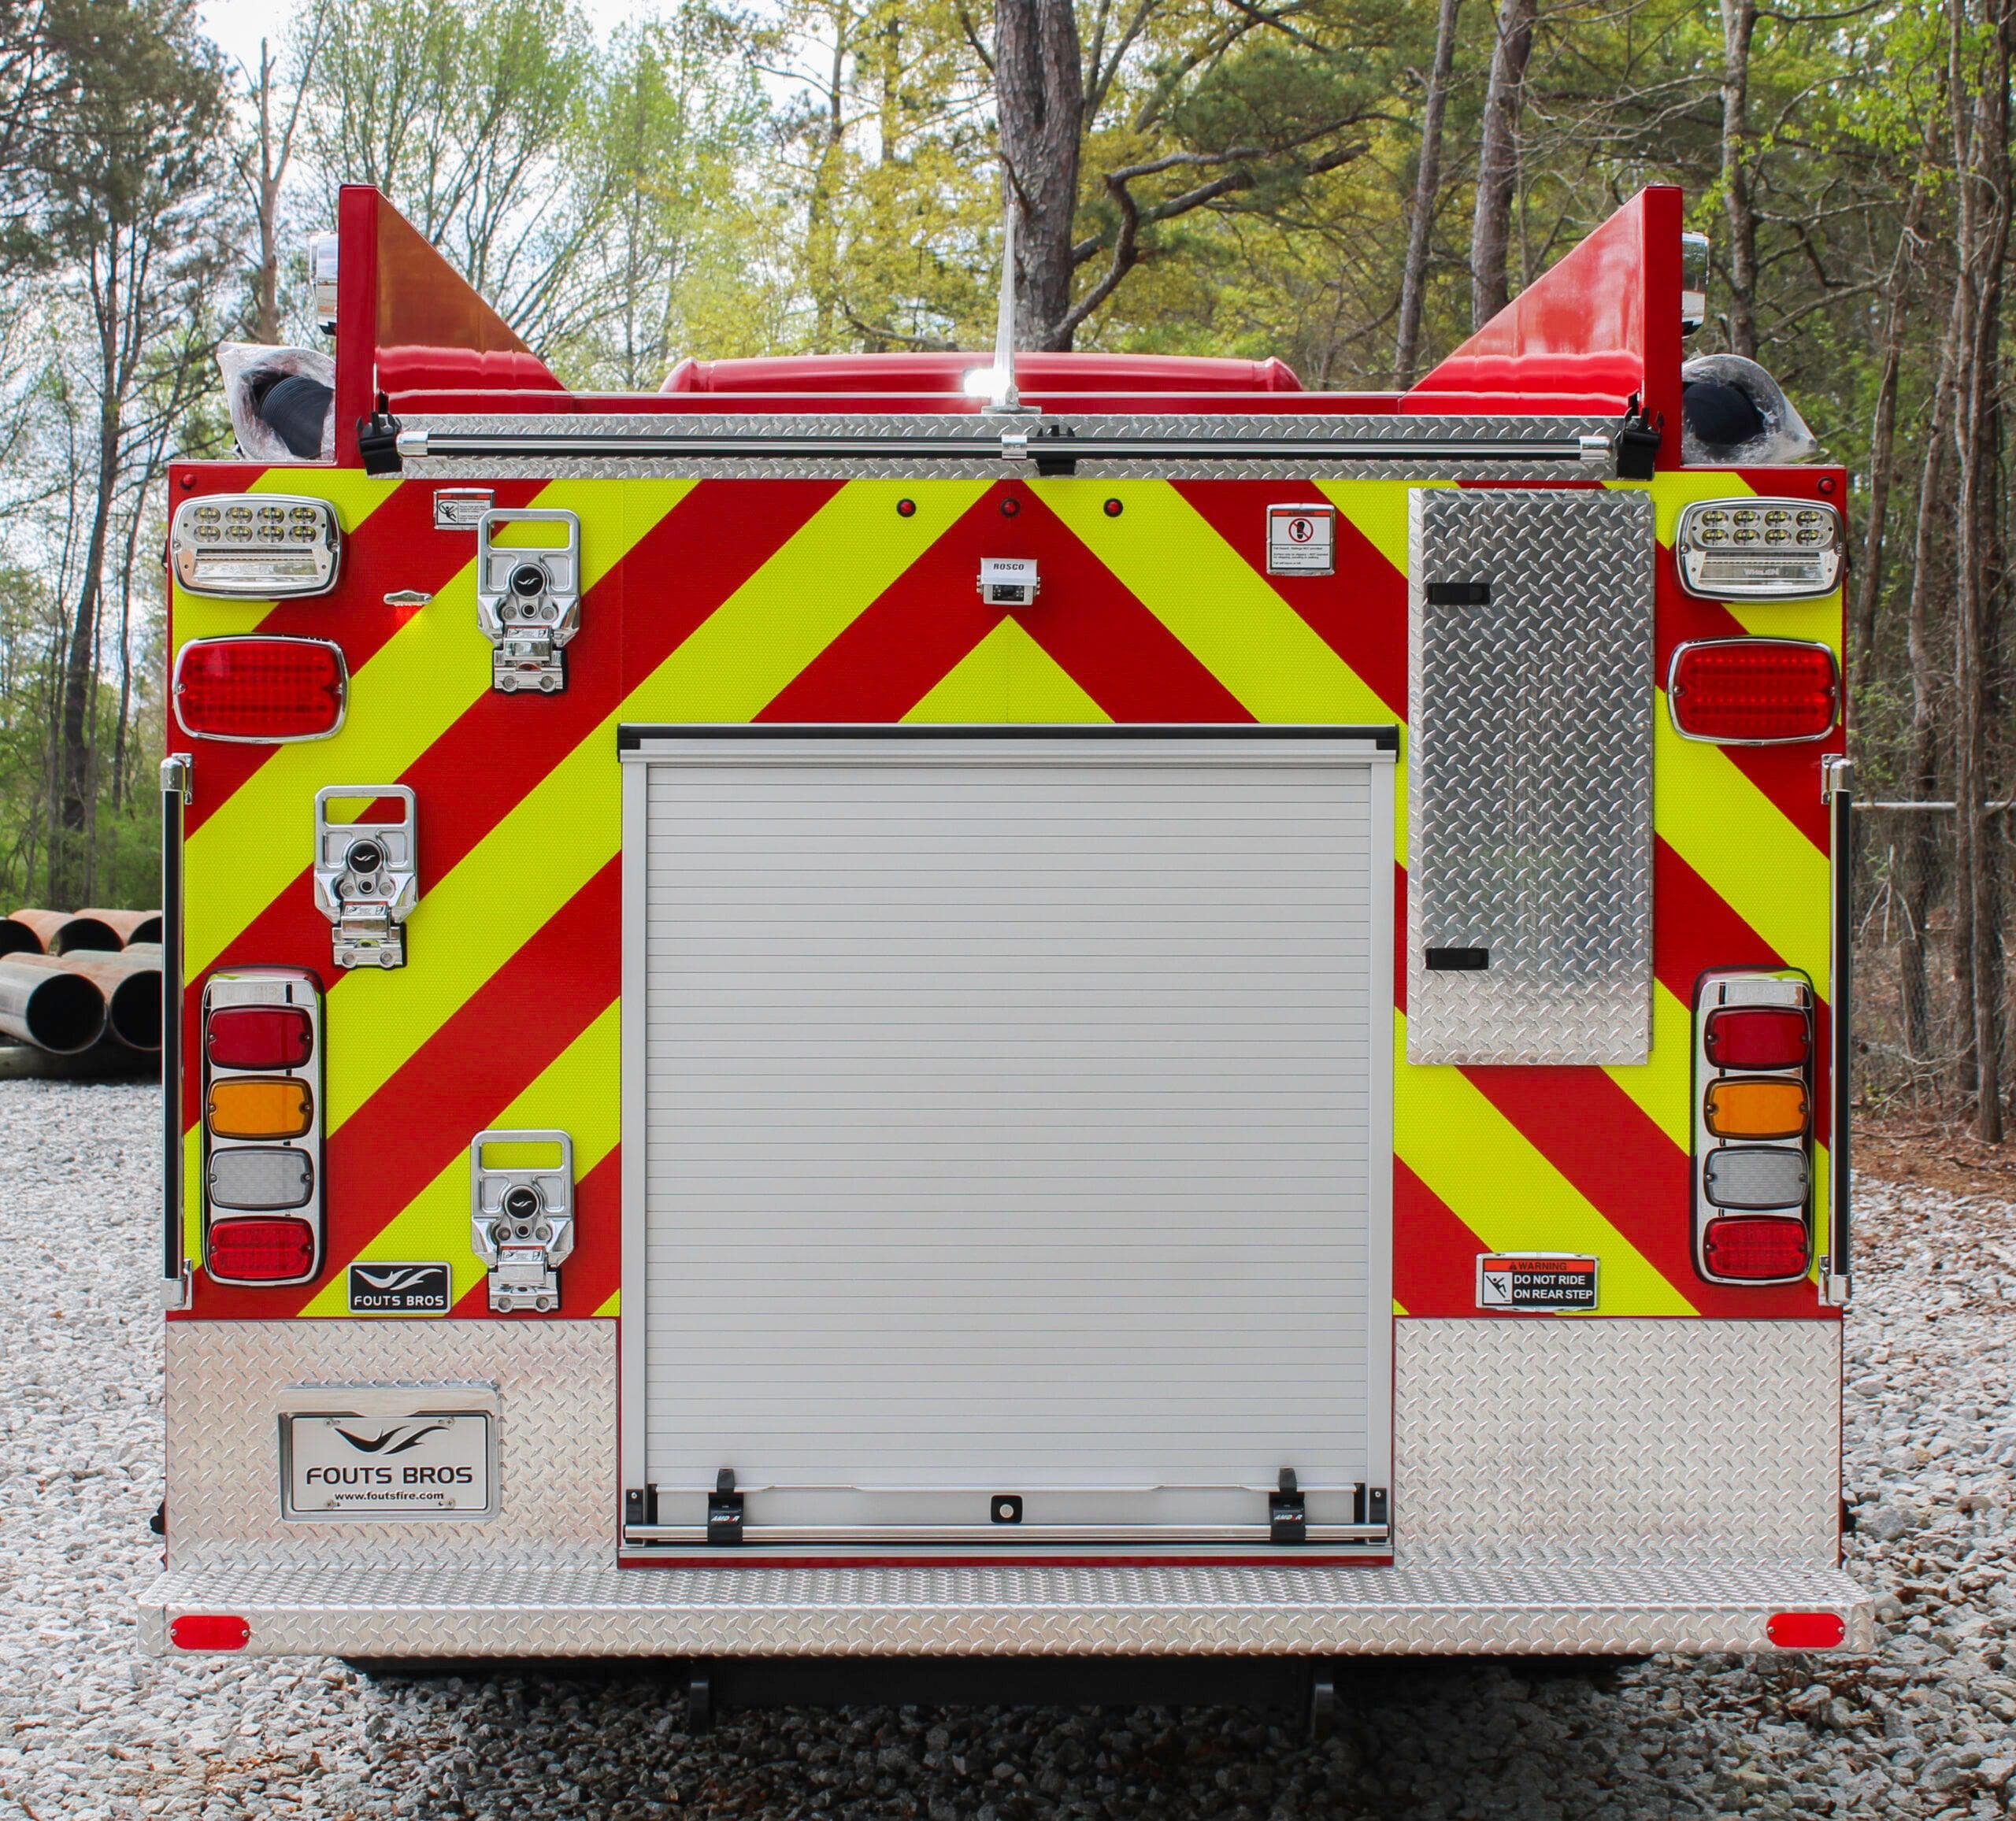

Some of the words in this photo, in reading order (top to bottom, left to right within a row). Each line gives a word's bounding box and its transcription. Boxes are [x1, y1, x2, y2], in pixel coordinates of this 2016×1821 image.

[1518, 1262, 1567, 1271] WARNING
[1514, 1275, 1531, 1285] DO
[1533, 1275, 1556, 1285] NOT
[1558, 1275, 1585, 1285] RIDE
[1514, 1290, 1530, 1299] ON
[1532, 1290, 1563, 1299] REAR
[1565, 1290, 1593, 1299] STEP
[354, 1295, 401, 1306] FOUTS
[406, 1295, 444, 1306] BROS
[306, 1466, 392, 1485] FOUTS
[403, 1466, 473, 1485] BROS
[335, 1490, 444, 1500] www.foutsfire.com
